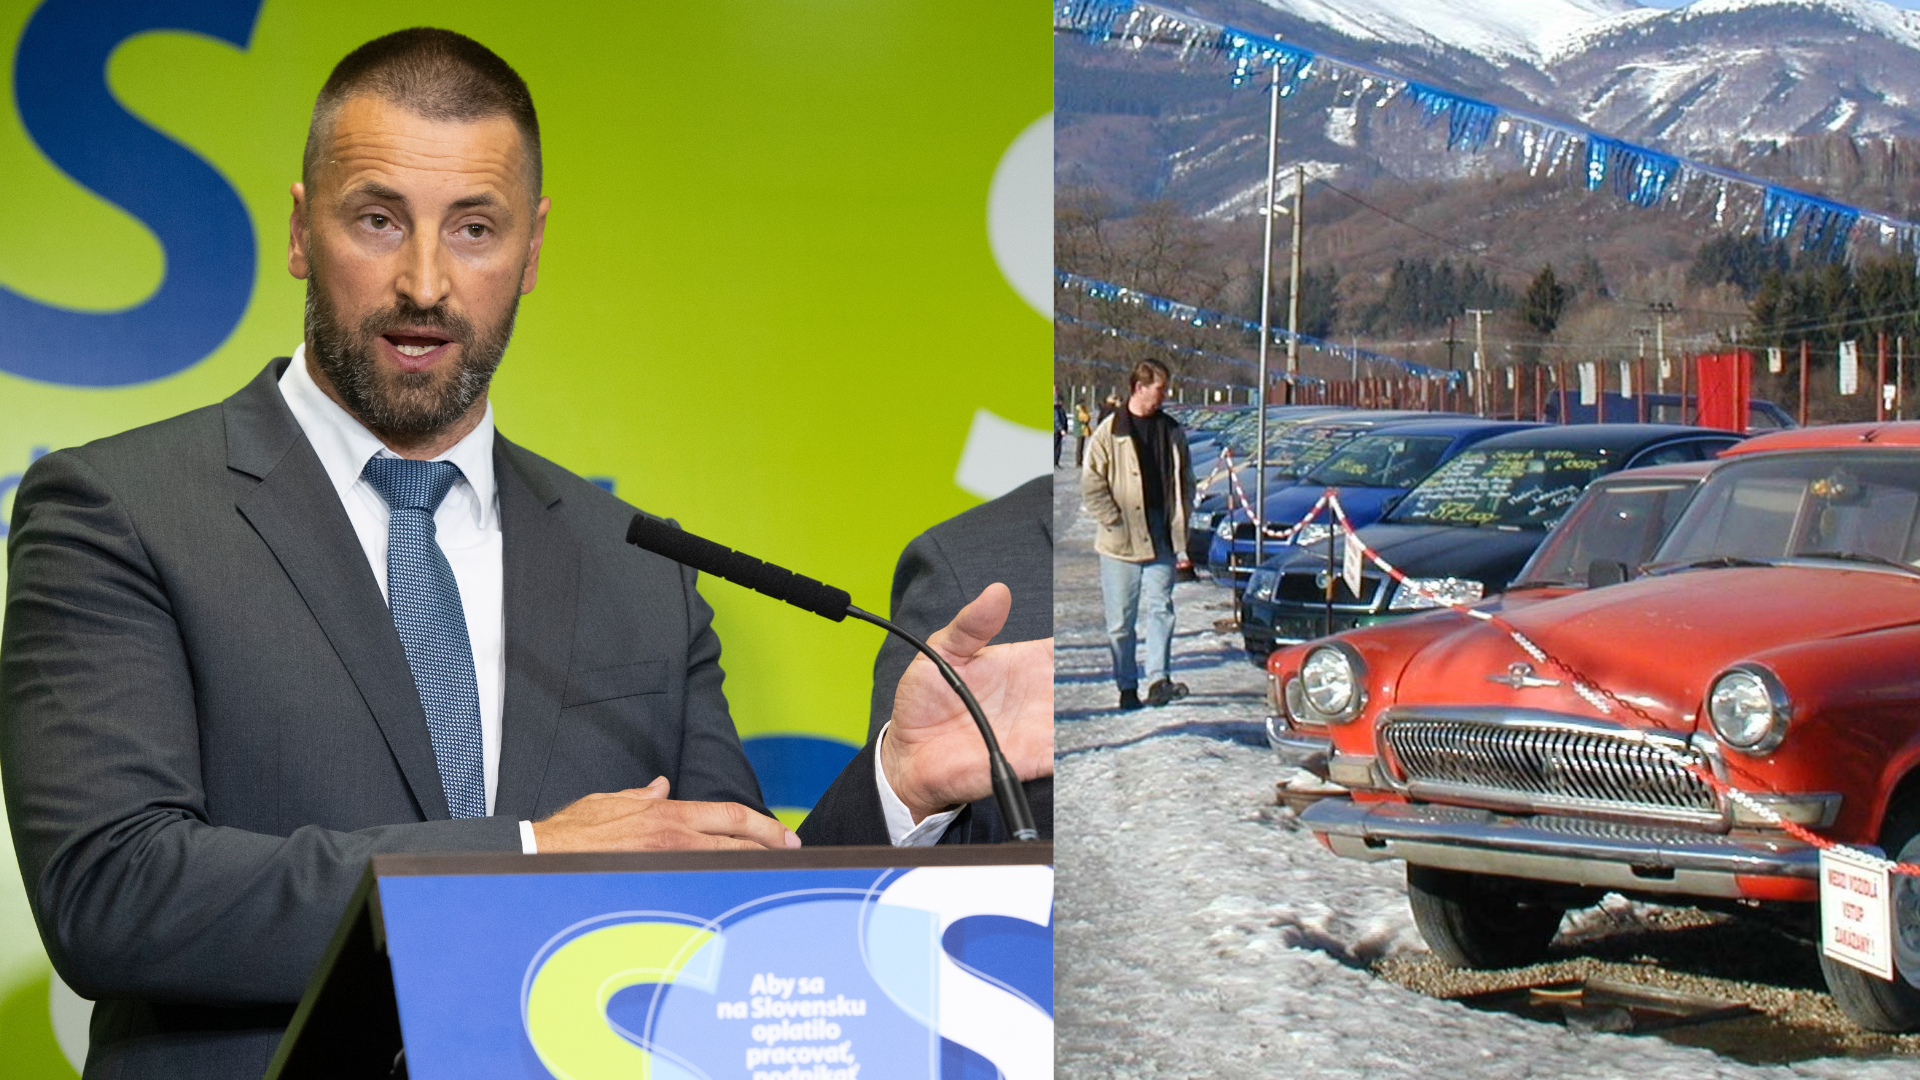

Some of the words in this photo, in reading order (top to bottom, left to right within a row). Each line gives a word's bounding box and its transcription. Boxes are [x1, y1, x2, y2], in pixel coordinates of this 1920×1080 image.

[750, 972, 796, 1000] Aby
[798, 976, 825, 995] sa
[717, 1001, 748, 1020] na
[750, 993, 867, 1019] Slovensku
[751, 1017, 842, 1046] oplatilo
[746, 1039, 855, 1071] pracovať,
